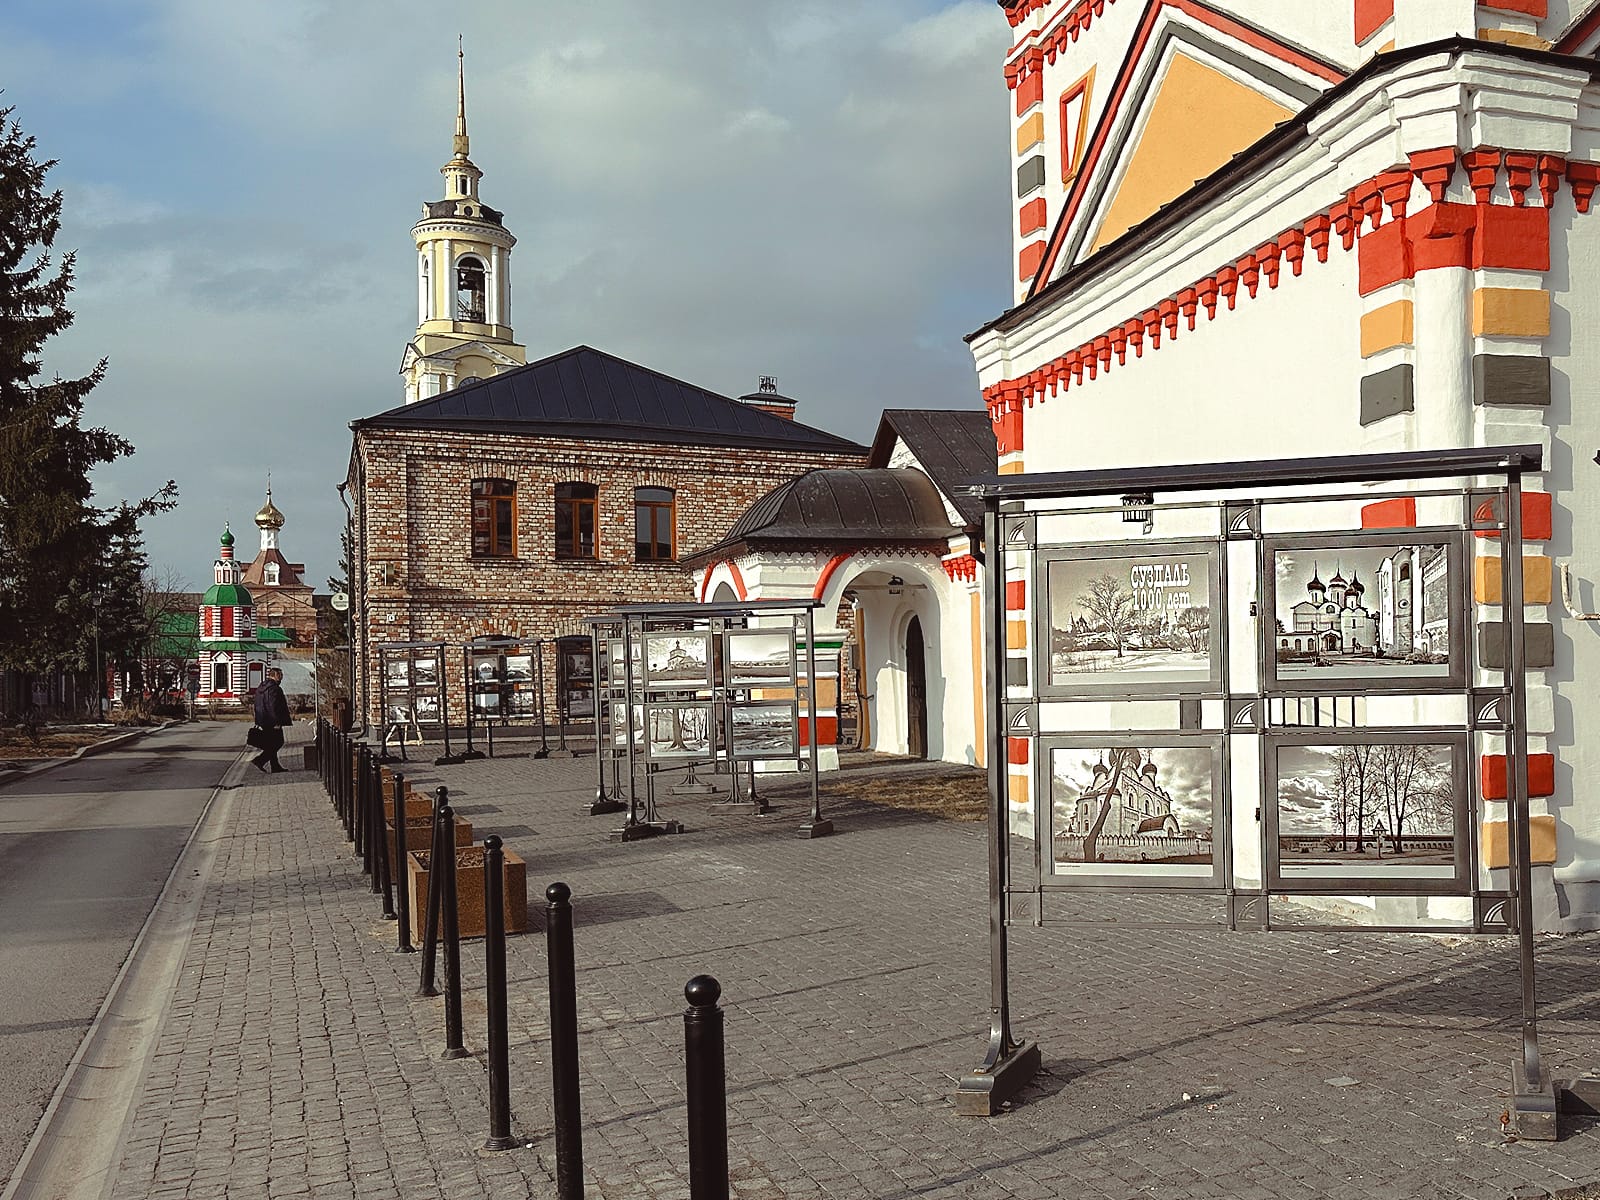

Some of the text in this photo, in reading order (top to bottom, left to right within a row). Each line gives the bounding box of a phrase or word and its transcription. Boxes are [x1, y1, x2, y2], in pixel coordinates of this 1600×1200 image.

[1131, 564, 1190, 592] СУЗДАЛЬ
[1133, 588, 1191, 611] 1000 лет
